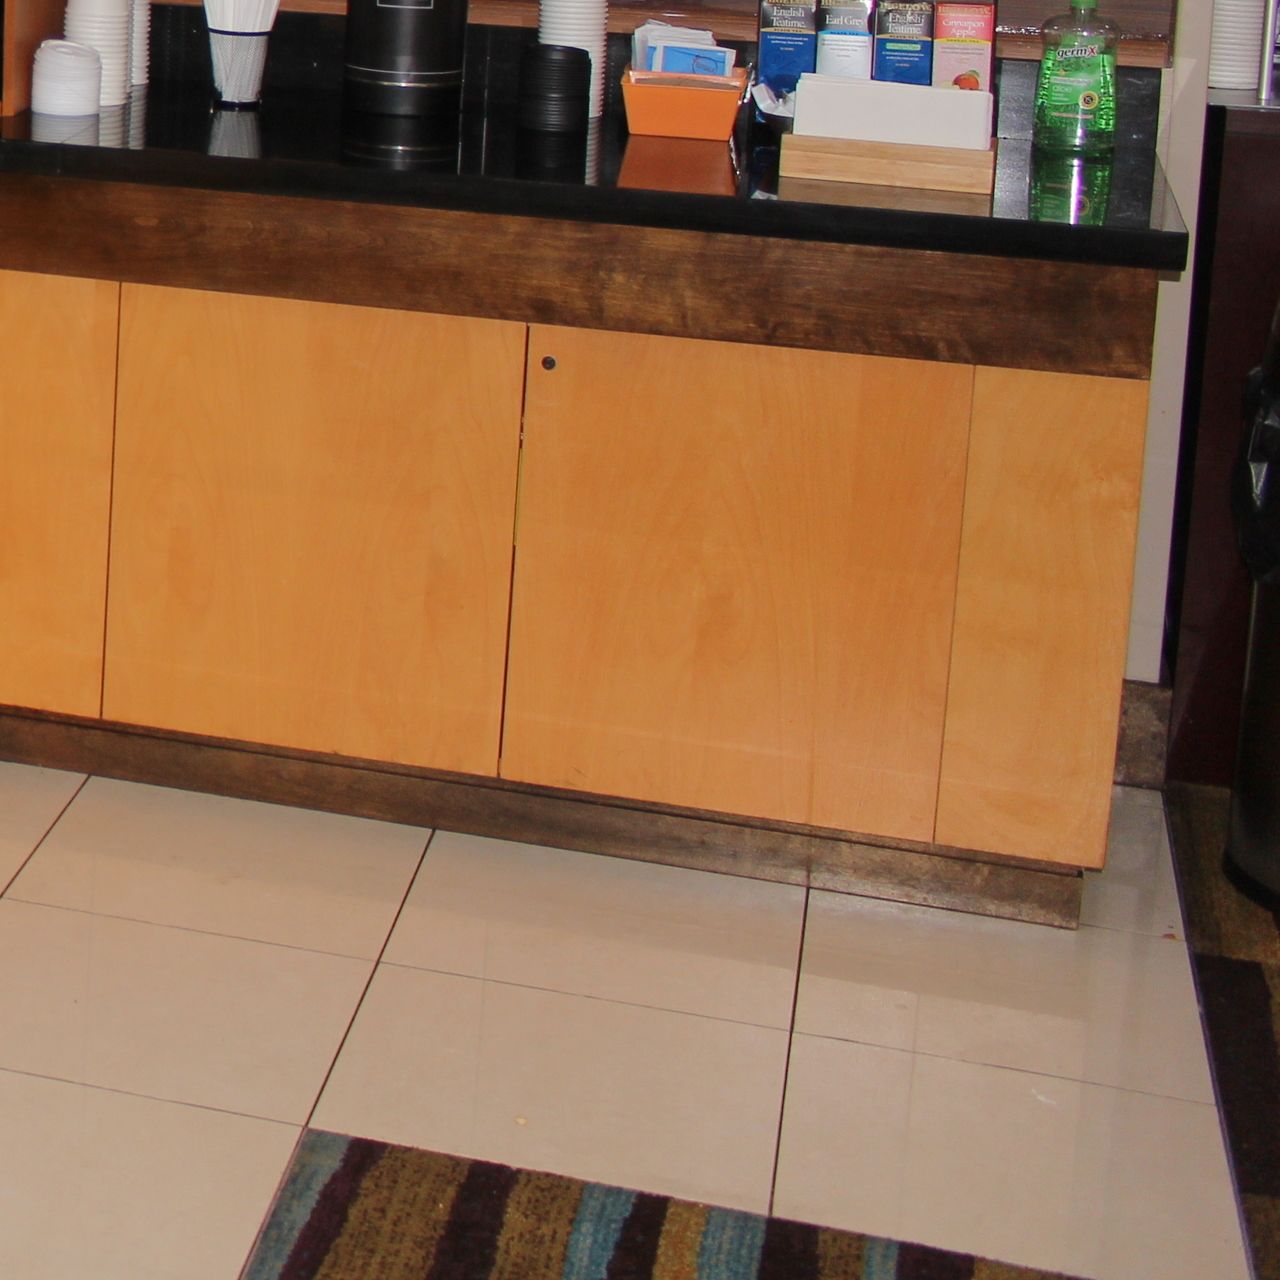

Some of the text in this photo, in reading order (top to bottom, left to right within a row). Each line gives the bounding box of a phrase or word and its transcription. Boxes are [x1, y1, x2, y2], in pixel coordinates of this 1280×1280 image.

[773, 6, 805, 17] English
[825, 14, 863, 28] Earl Grey
[942, 19, 985, 28] Cinnamon
[950, 28, 977, 39] Apple
